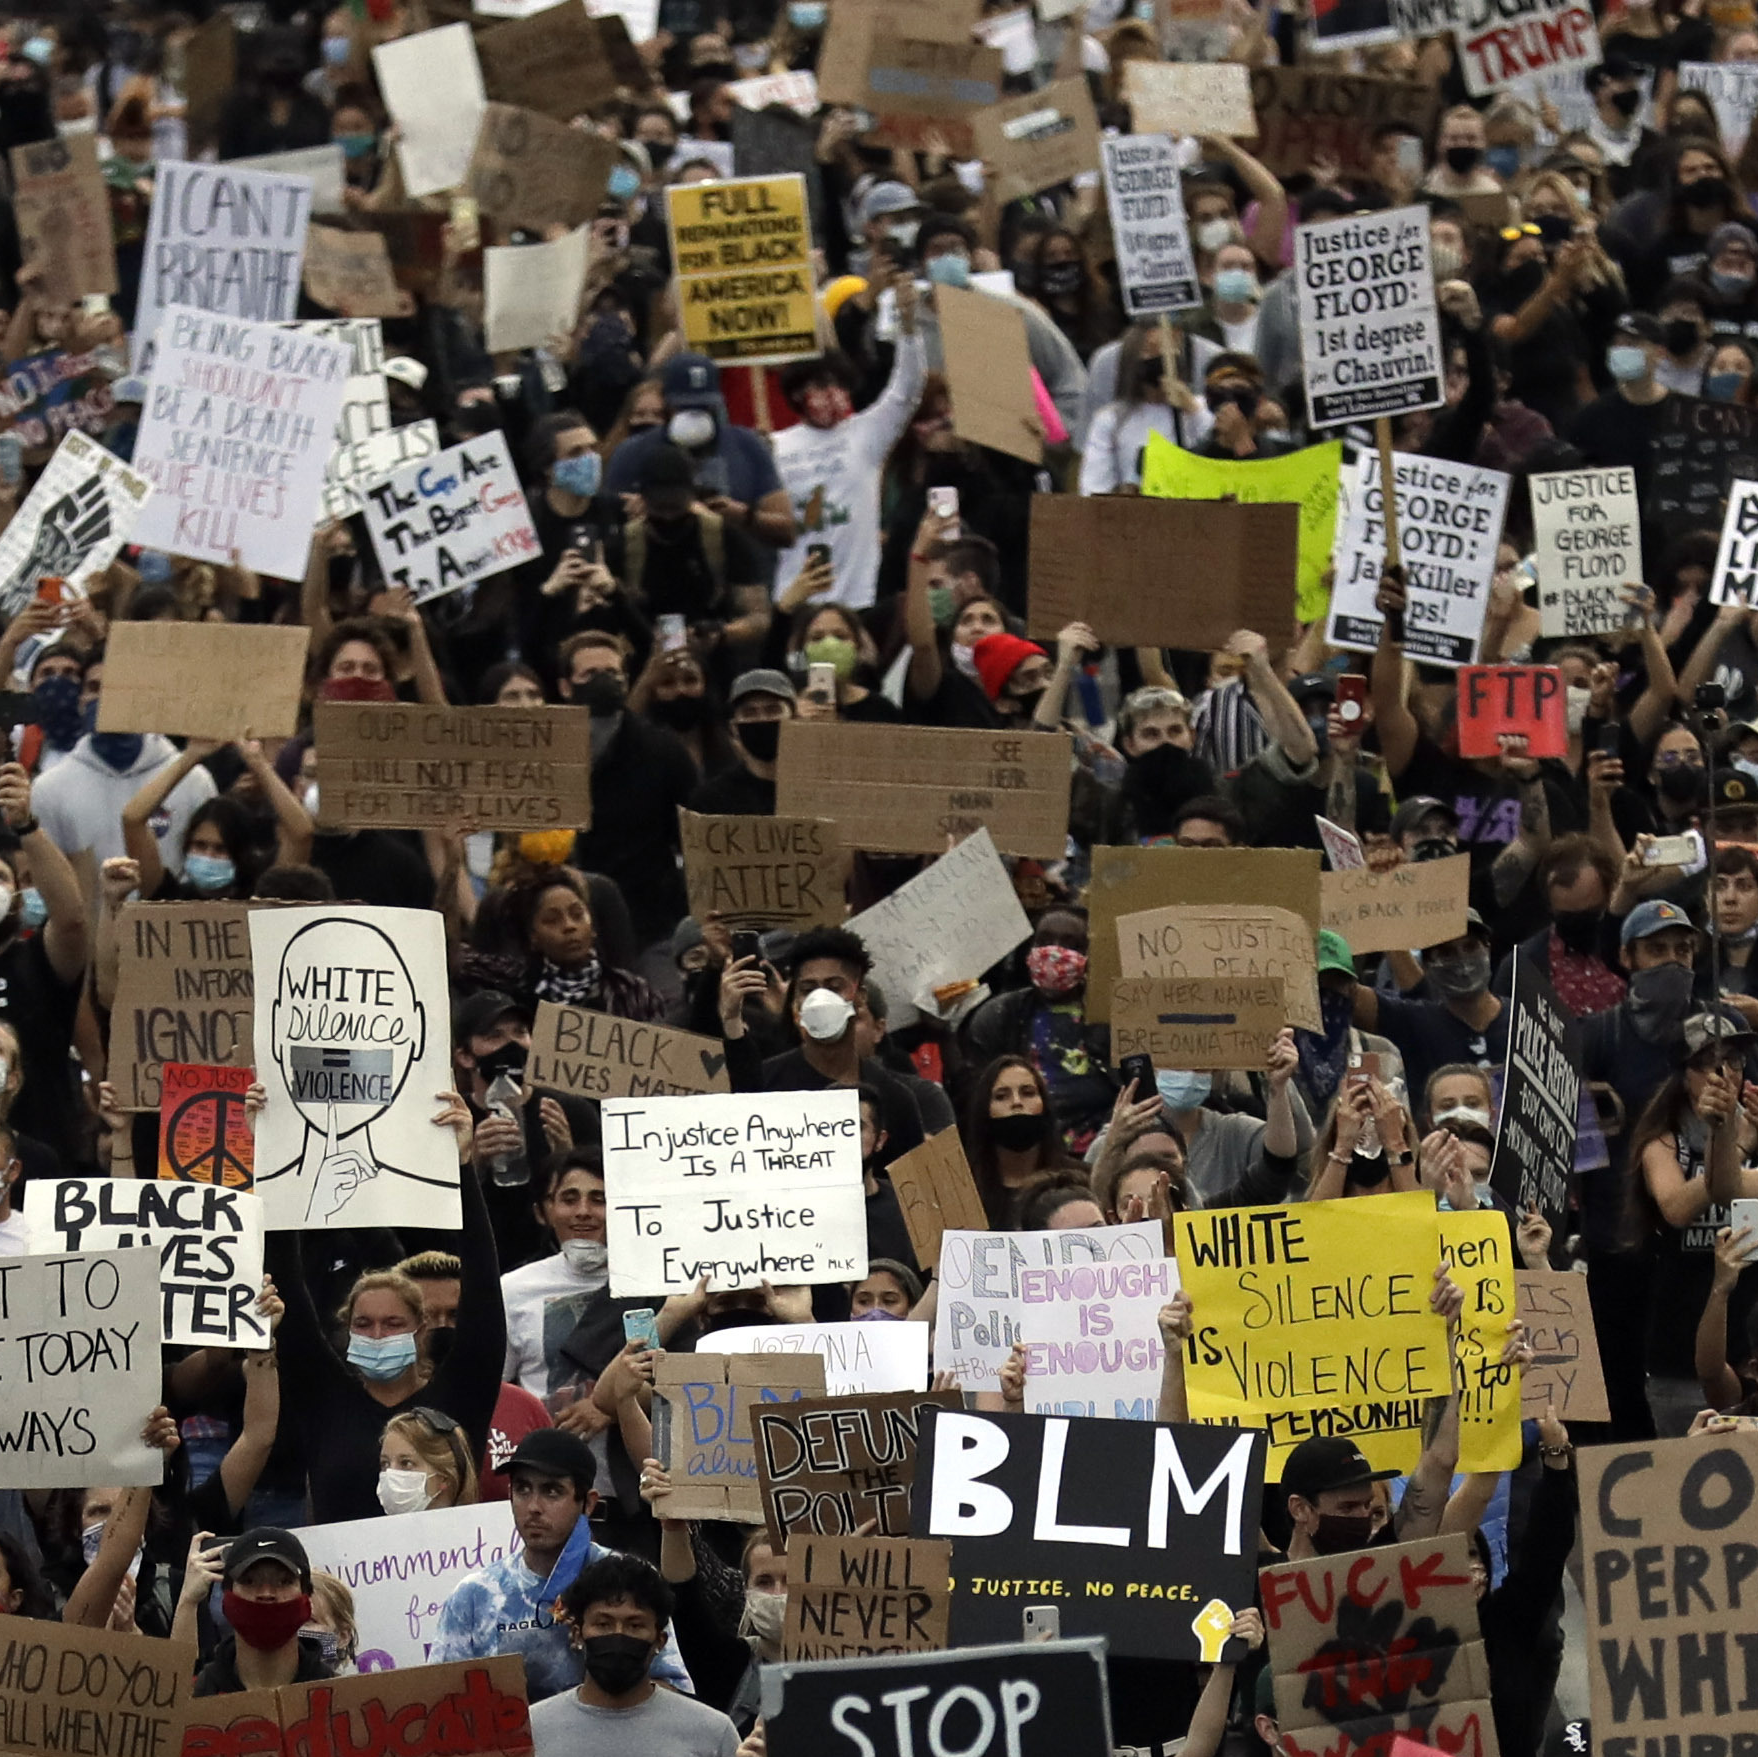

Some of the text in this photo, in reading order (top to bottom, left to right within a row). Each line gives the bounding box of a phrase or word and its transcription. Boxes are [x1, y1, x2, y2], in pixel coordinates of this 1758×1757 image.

[1465, 8, 1591, 85] TRUMP
[698, 185, 781, 217] FULL
[713, 236, 802, 269] BLACK
[1301, 229, 1390, 265] Justice
[1304, 244, 1425, 291] GEORGE
[687, 273, 806, 305] AMERICA
[1313, 281, 1421, 319] FLOYD:
[172, 315, 348, 381] BEING BLACK
[1315, 321, 1427, 360] 1st degree
[1331, 350, 1438, 388] Chauvin!
[154, 384, 189, 423] BE
[193, 398, 215, 432] A
[203, 465, 287, 518] LIVES
[1536, 471, 1633, 506] JUSTICE
[1567, 503, 1609, 525] FOR
[1554, 526, 1633, 553] GEORGE
[1562, 554, 1628, 579] FLOYD
[285, 965, 397, 1009] WHITE
[292, 1069, 394, 1103] VIOLENCE
[745, 1115, 857, 1162] Anywhere
[729, 1150, 750, 1176] A
[755, 1147, 836, 1173] THREAT
[703, 1198, 816, 1233] Justice
[1186, 1210, 1310, 1270] WHITE
[47, 1258, 121, 1312] TO
[1241, 1274, 1416, 1329] SILENCE
[15, 1321, 141, 1385] TODAY
[1189, 1325, 1428, 1403] IS VIOLENCE
[928, 1412, 1256, 1557] BLM
[971, 1577, 1201, 1603] JUSTICE. NO PEACE.
